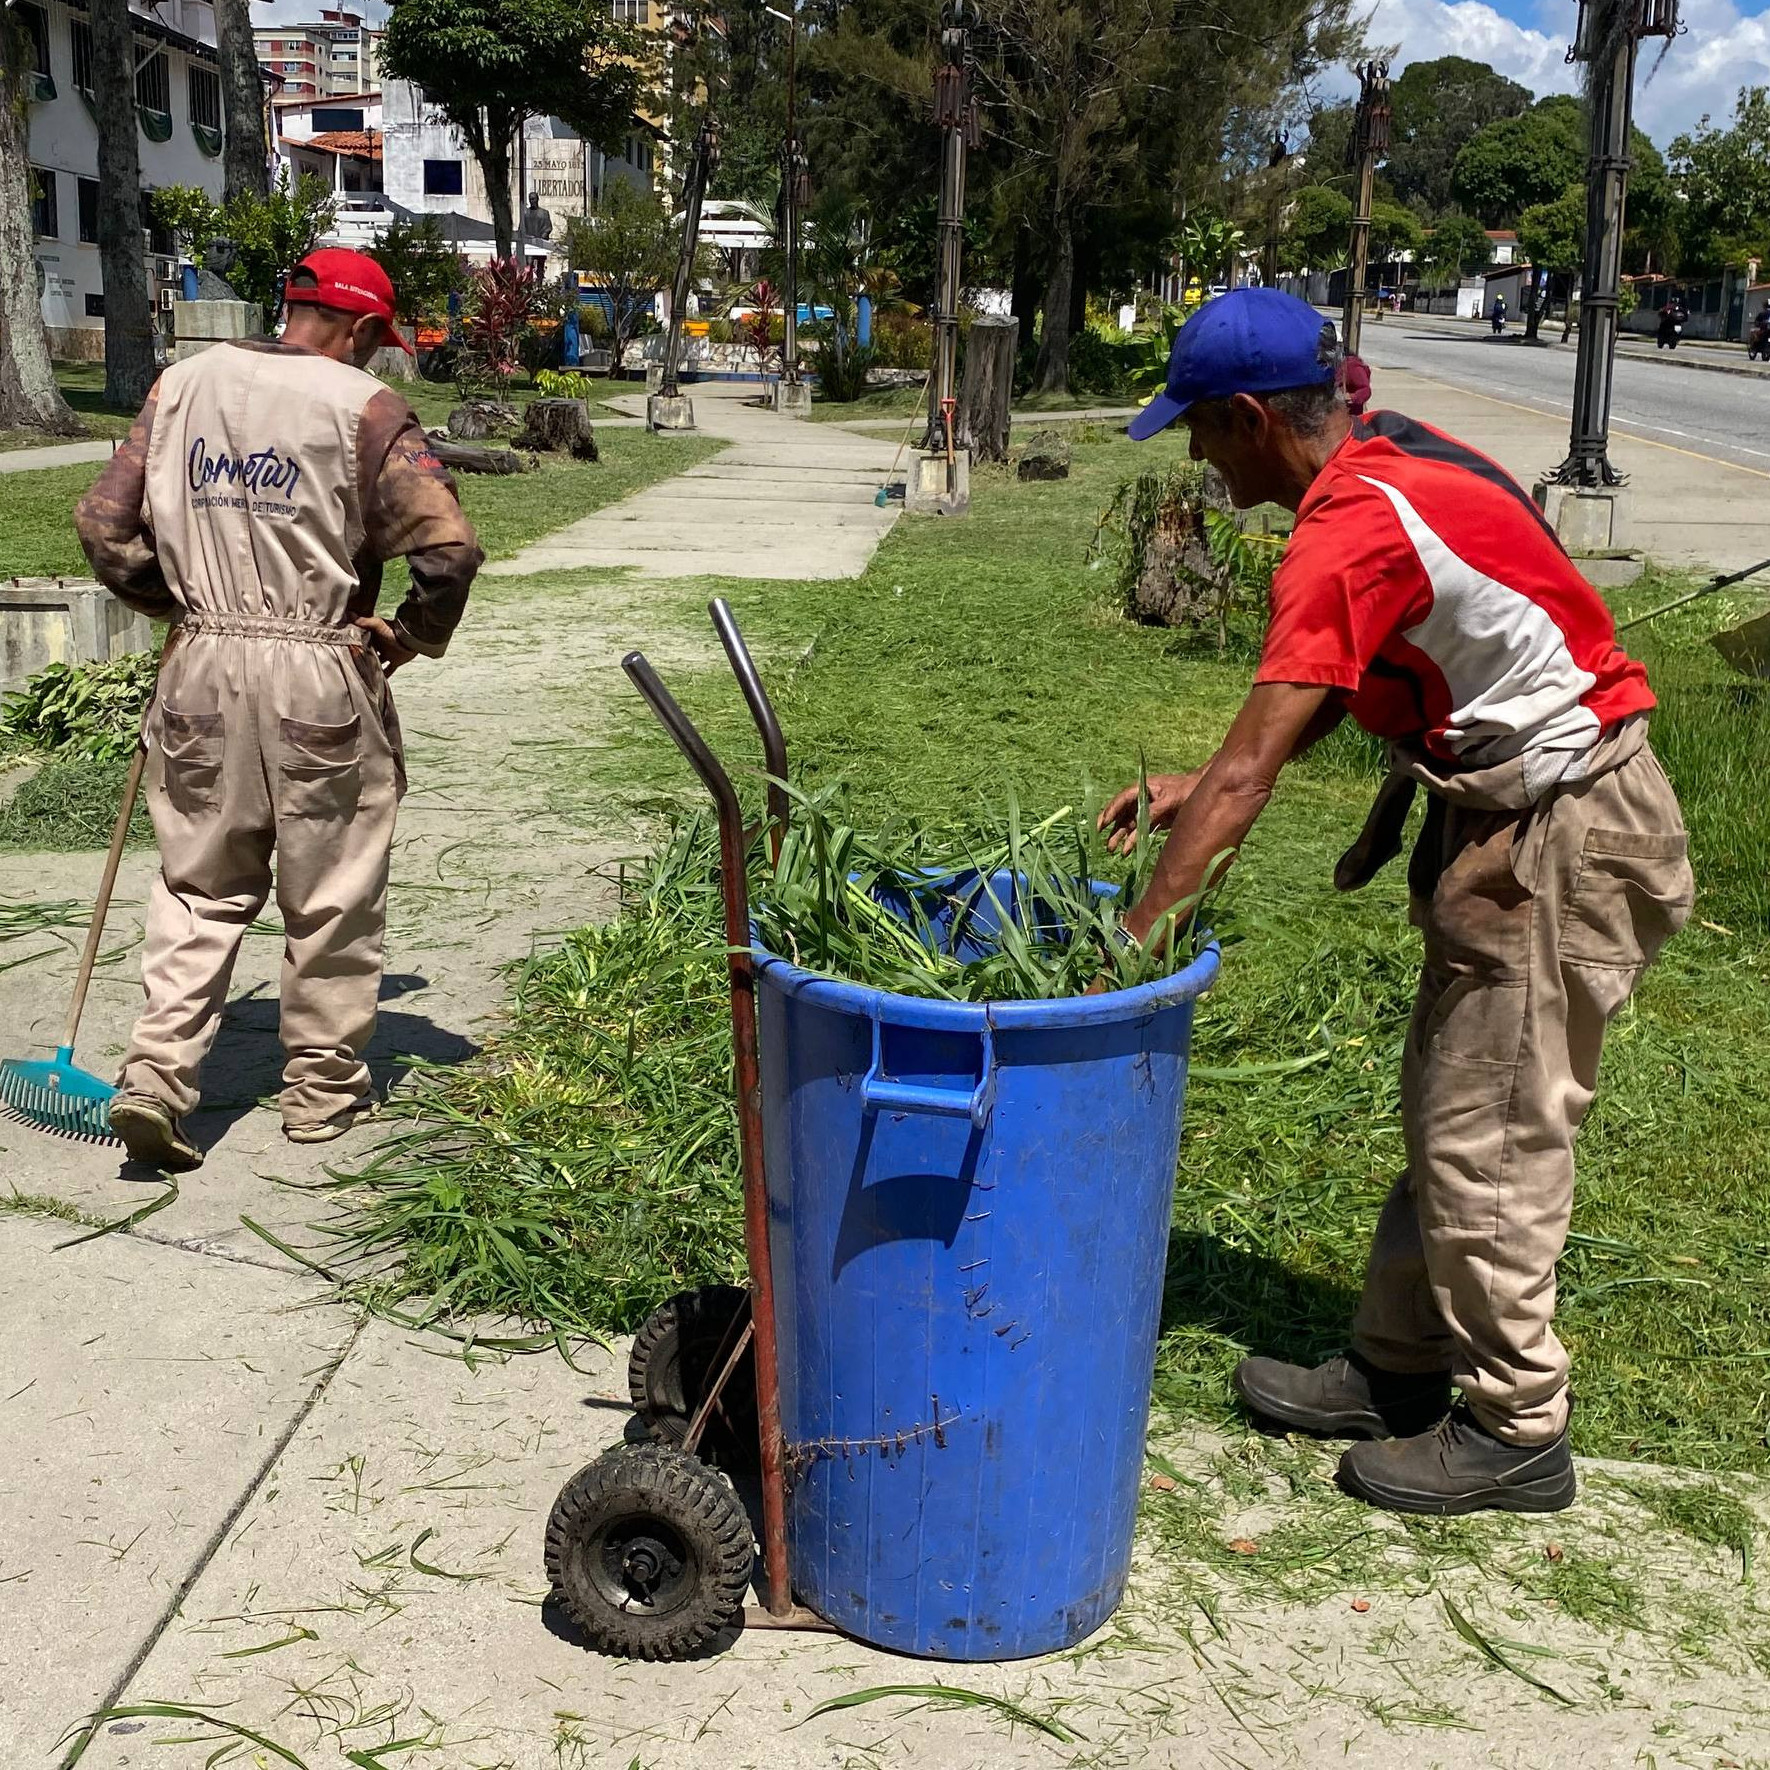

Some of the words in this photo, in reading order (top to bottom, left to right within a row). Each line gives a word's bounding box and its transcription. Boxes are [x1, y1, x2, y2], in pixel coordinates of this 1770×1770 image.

[545, 160, 567, 169] MAYO
[252, 501, 262, 512] DE
[265, 502, 297, 517] TURISMO
